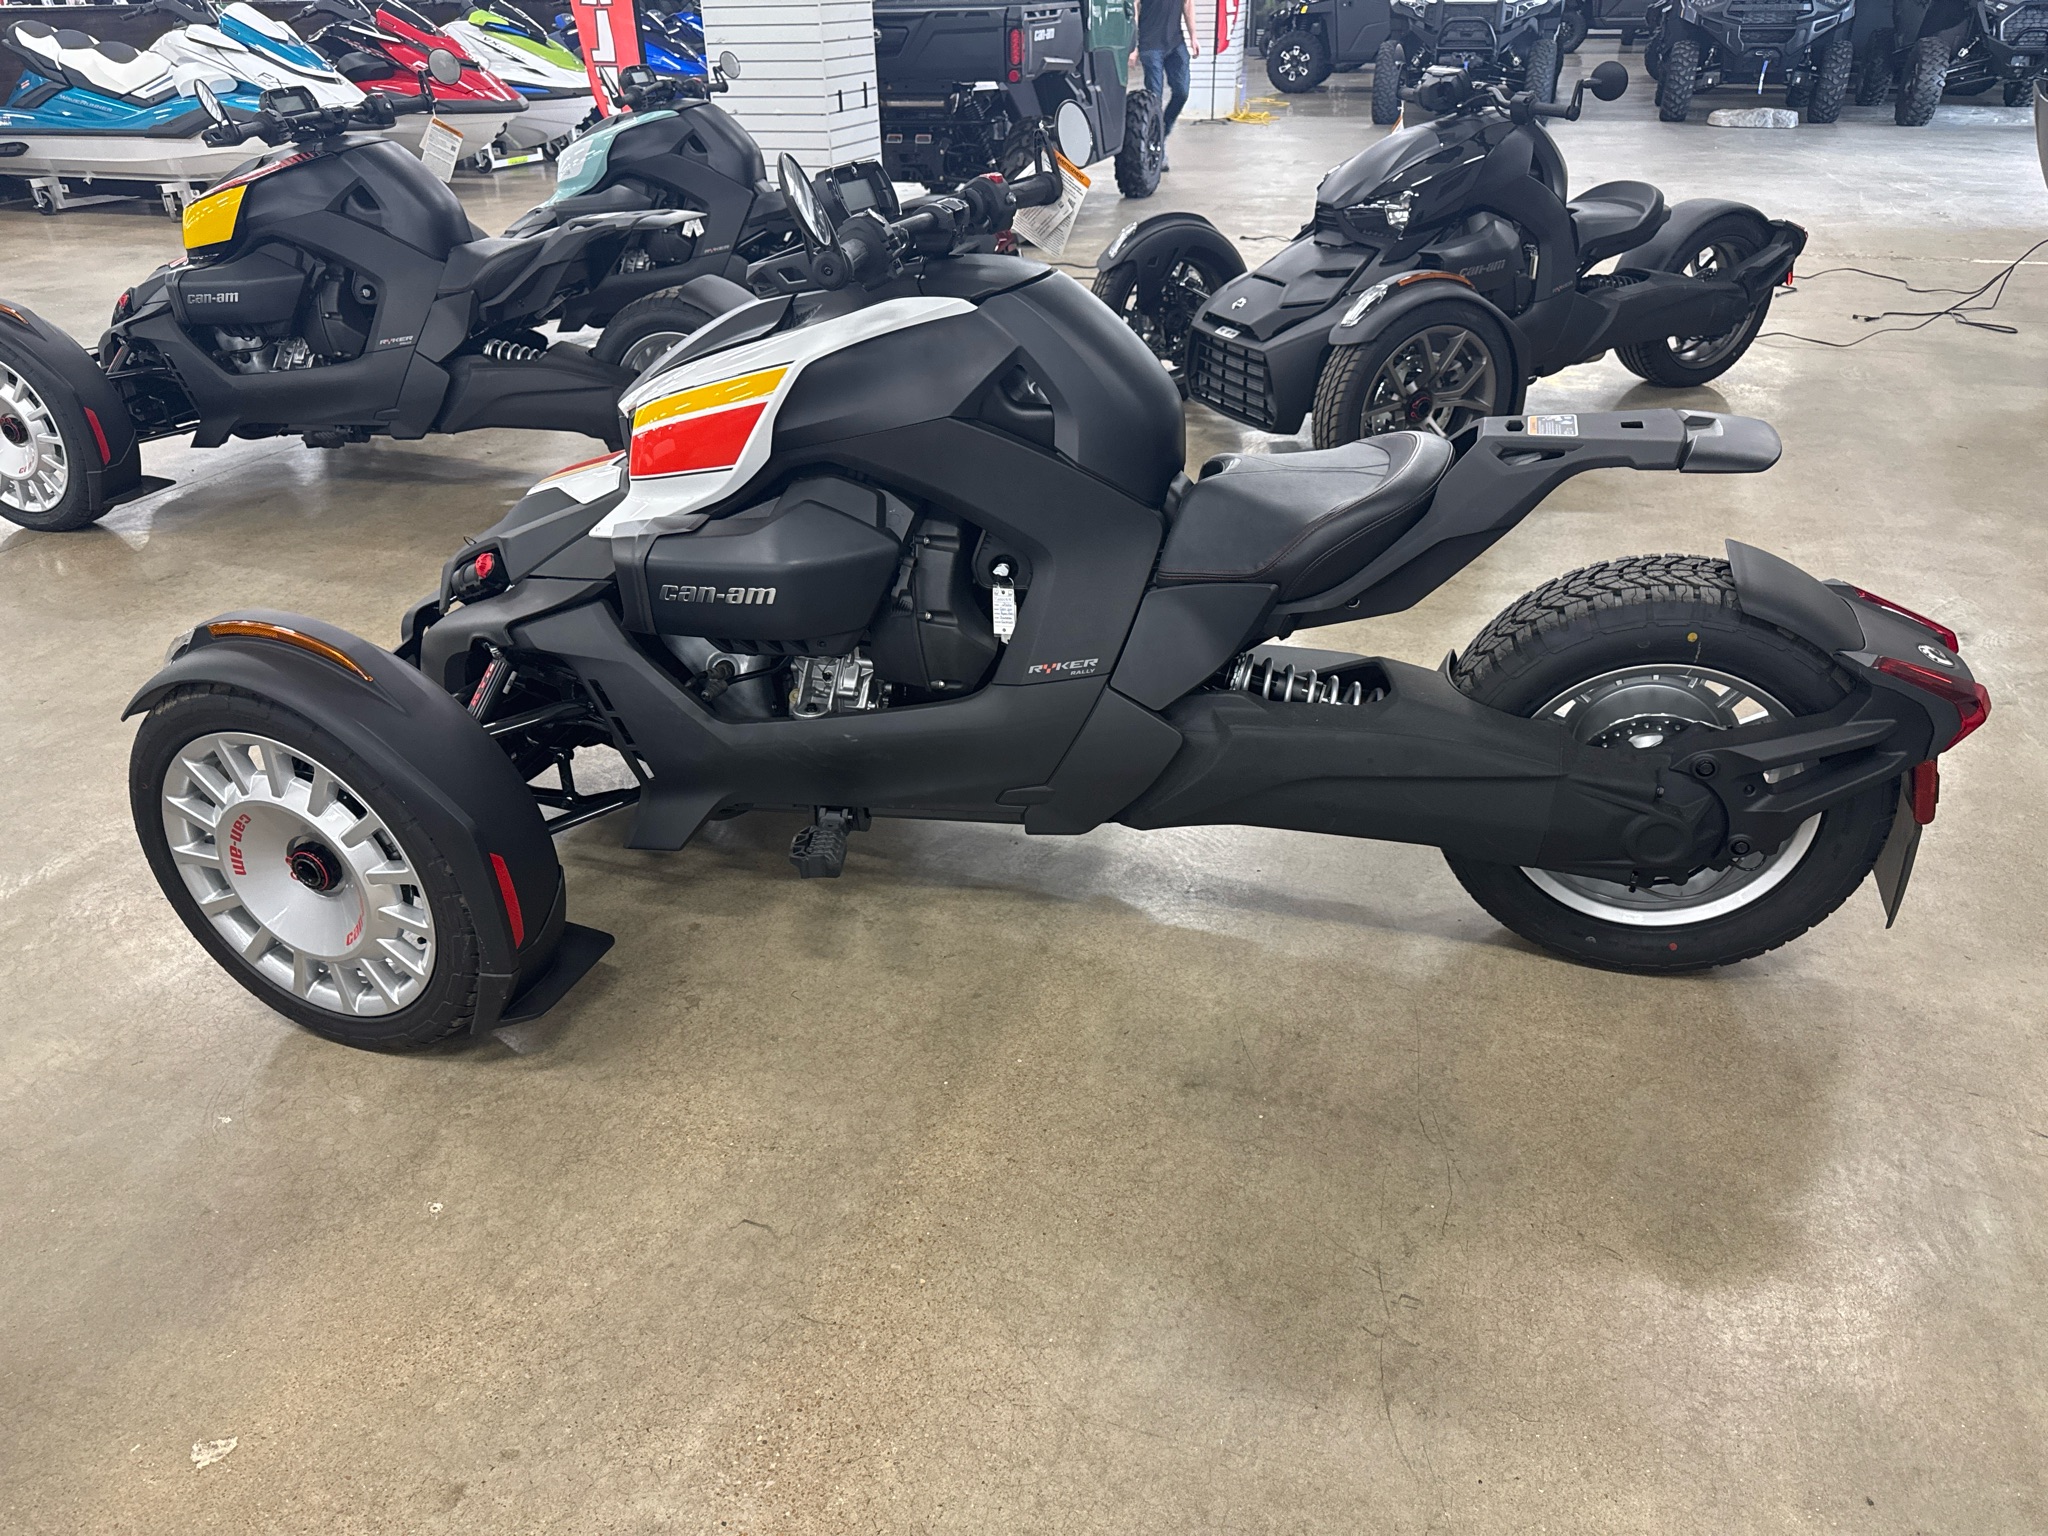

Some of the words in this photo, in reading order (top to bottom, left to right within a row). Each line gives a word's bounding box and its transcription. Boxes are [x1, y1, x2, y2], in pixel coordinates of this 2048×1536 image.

[1460, 259, 1506, 277] can-am
[187, 292, 239, 304] can-am
[659, 584, 776, 605] can-am
[1028, 658, 1099, 674] RYKER
[1070, 668, 1096, 676] RALLY
[229, 813, 251, 876] can-am
